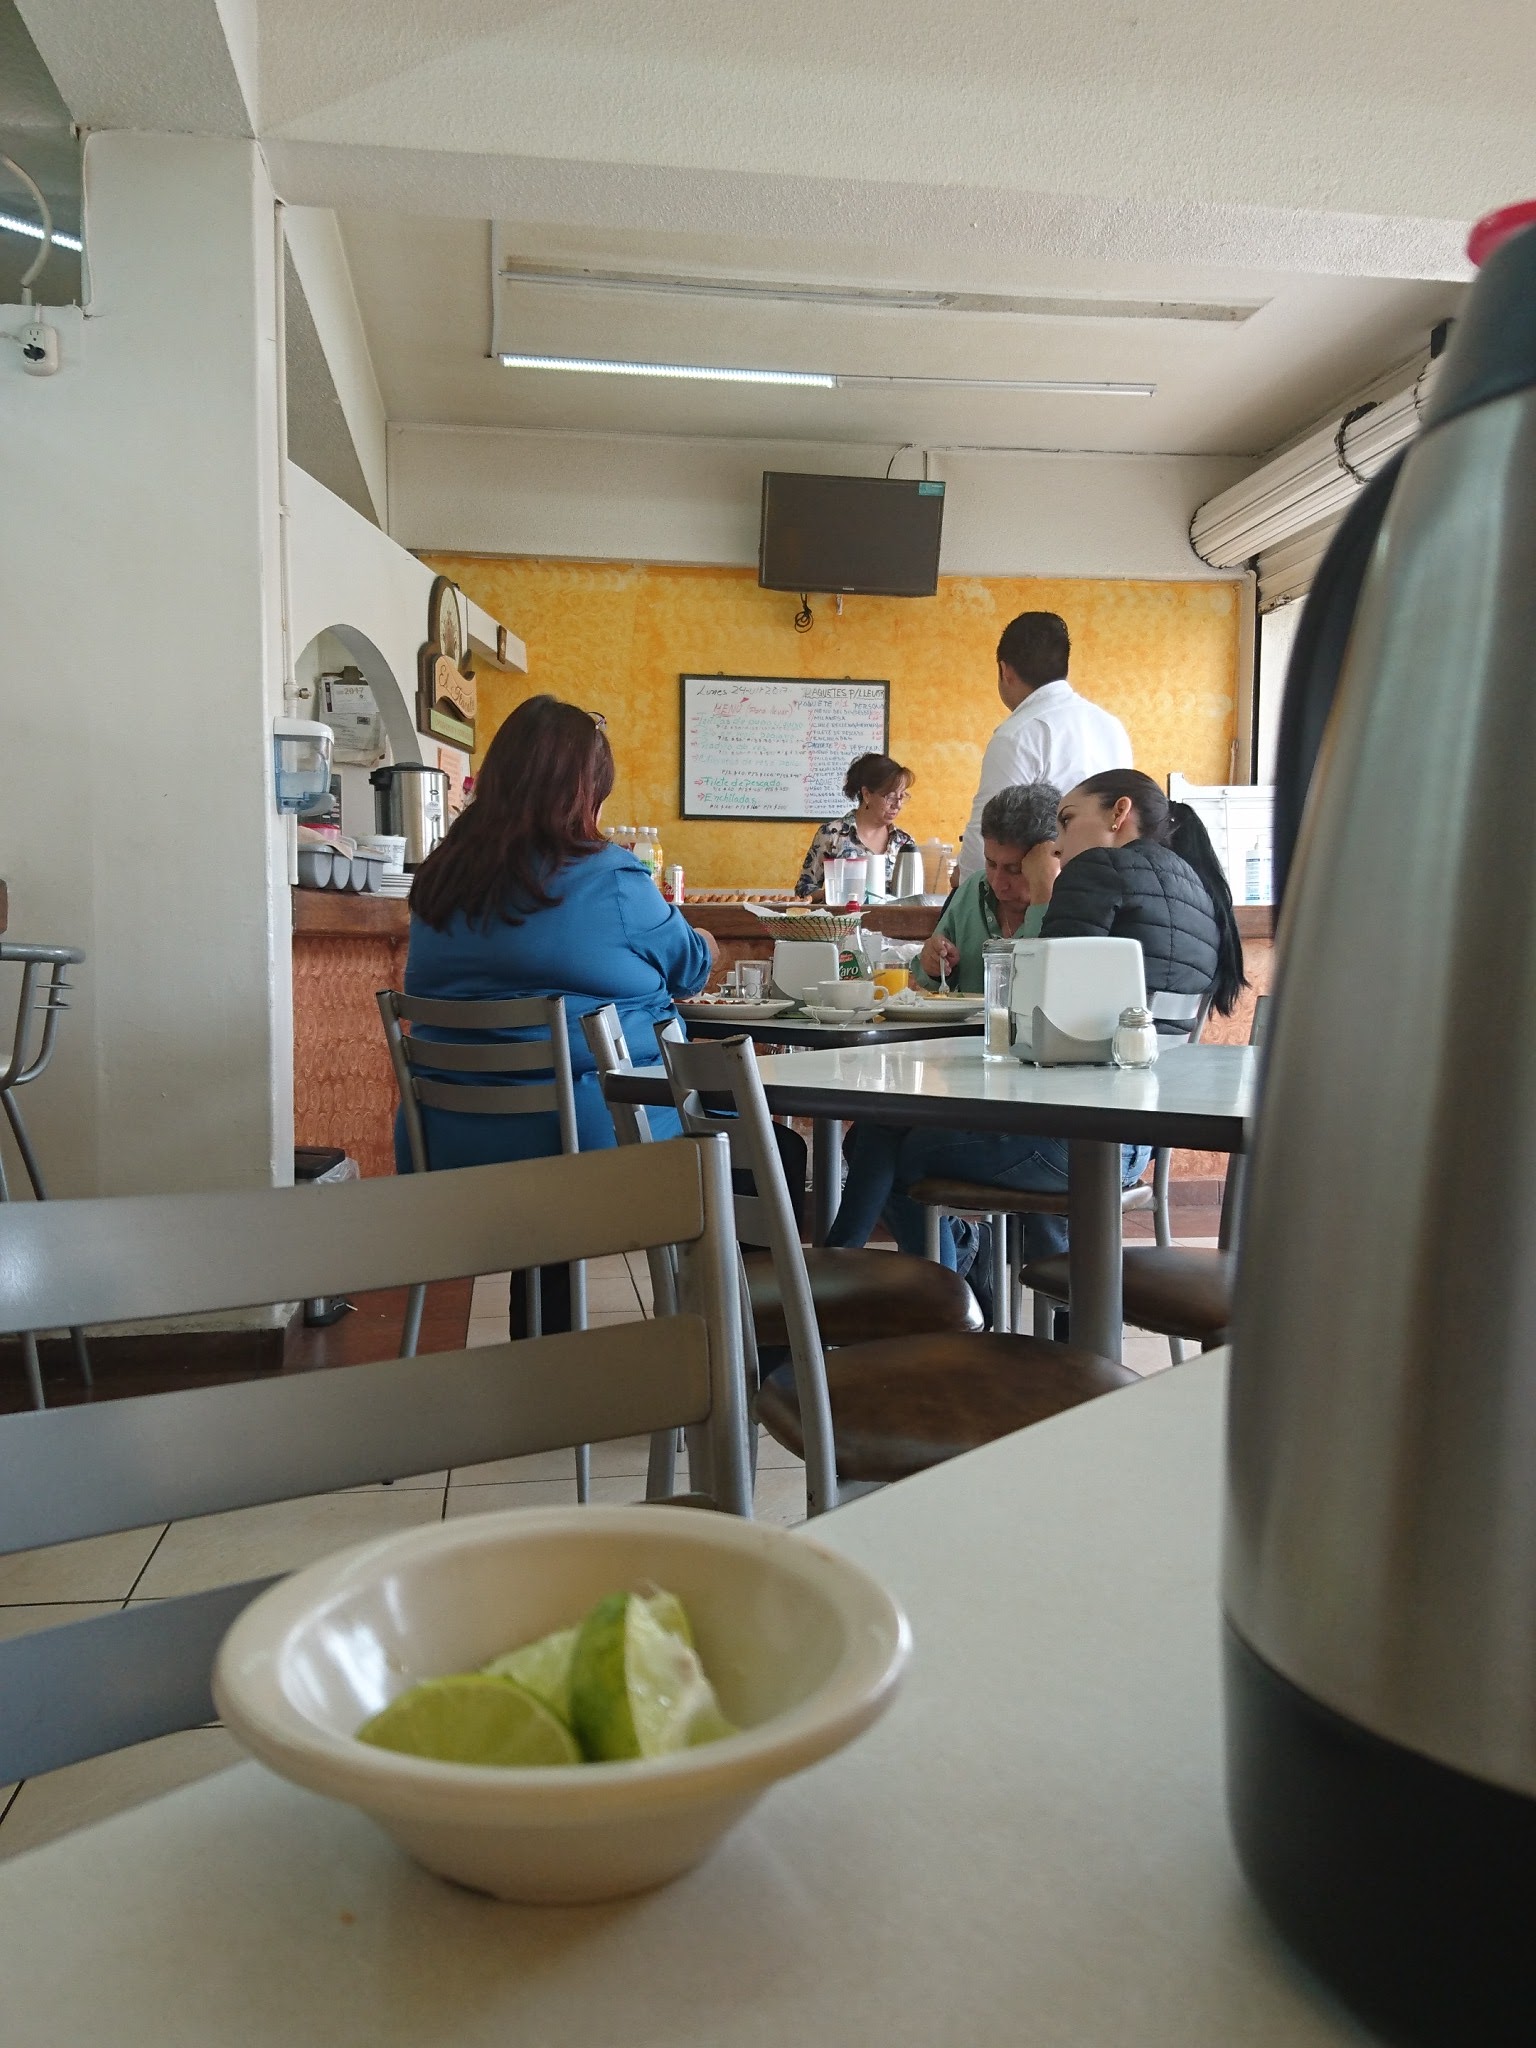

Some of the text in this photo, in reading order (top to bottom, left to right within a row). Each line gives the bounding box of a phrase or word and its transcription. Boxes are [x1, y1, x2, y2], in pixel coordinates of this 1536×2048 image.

[697, 684, 728, 696] Lunes
[803, 688, 848, 698] PAQUETES
[701, 776, 729, 788] Filete
[704, 793, 757, 804] Enchiladas
